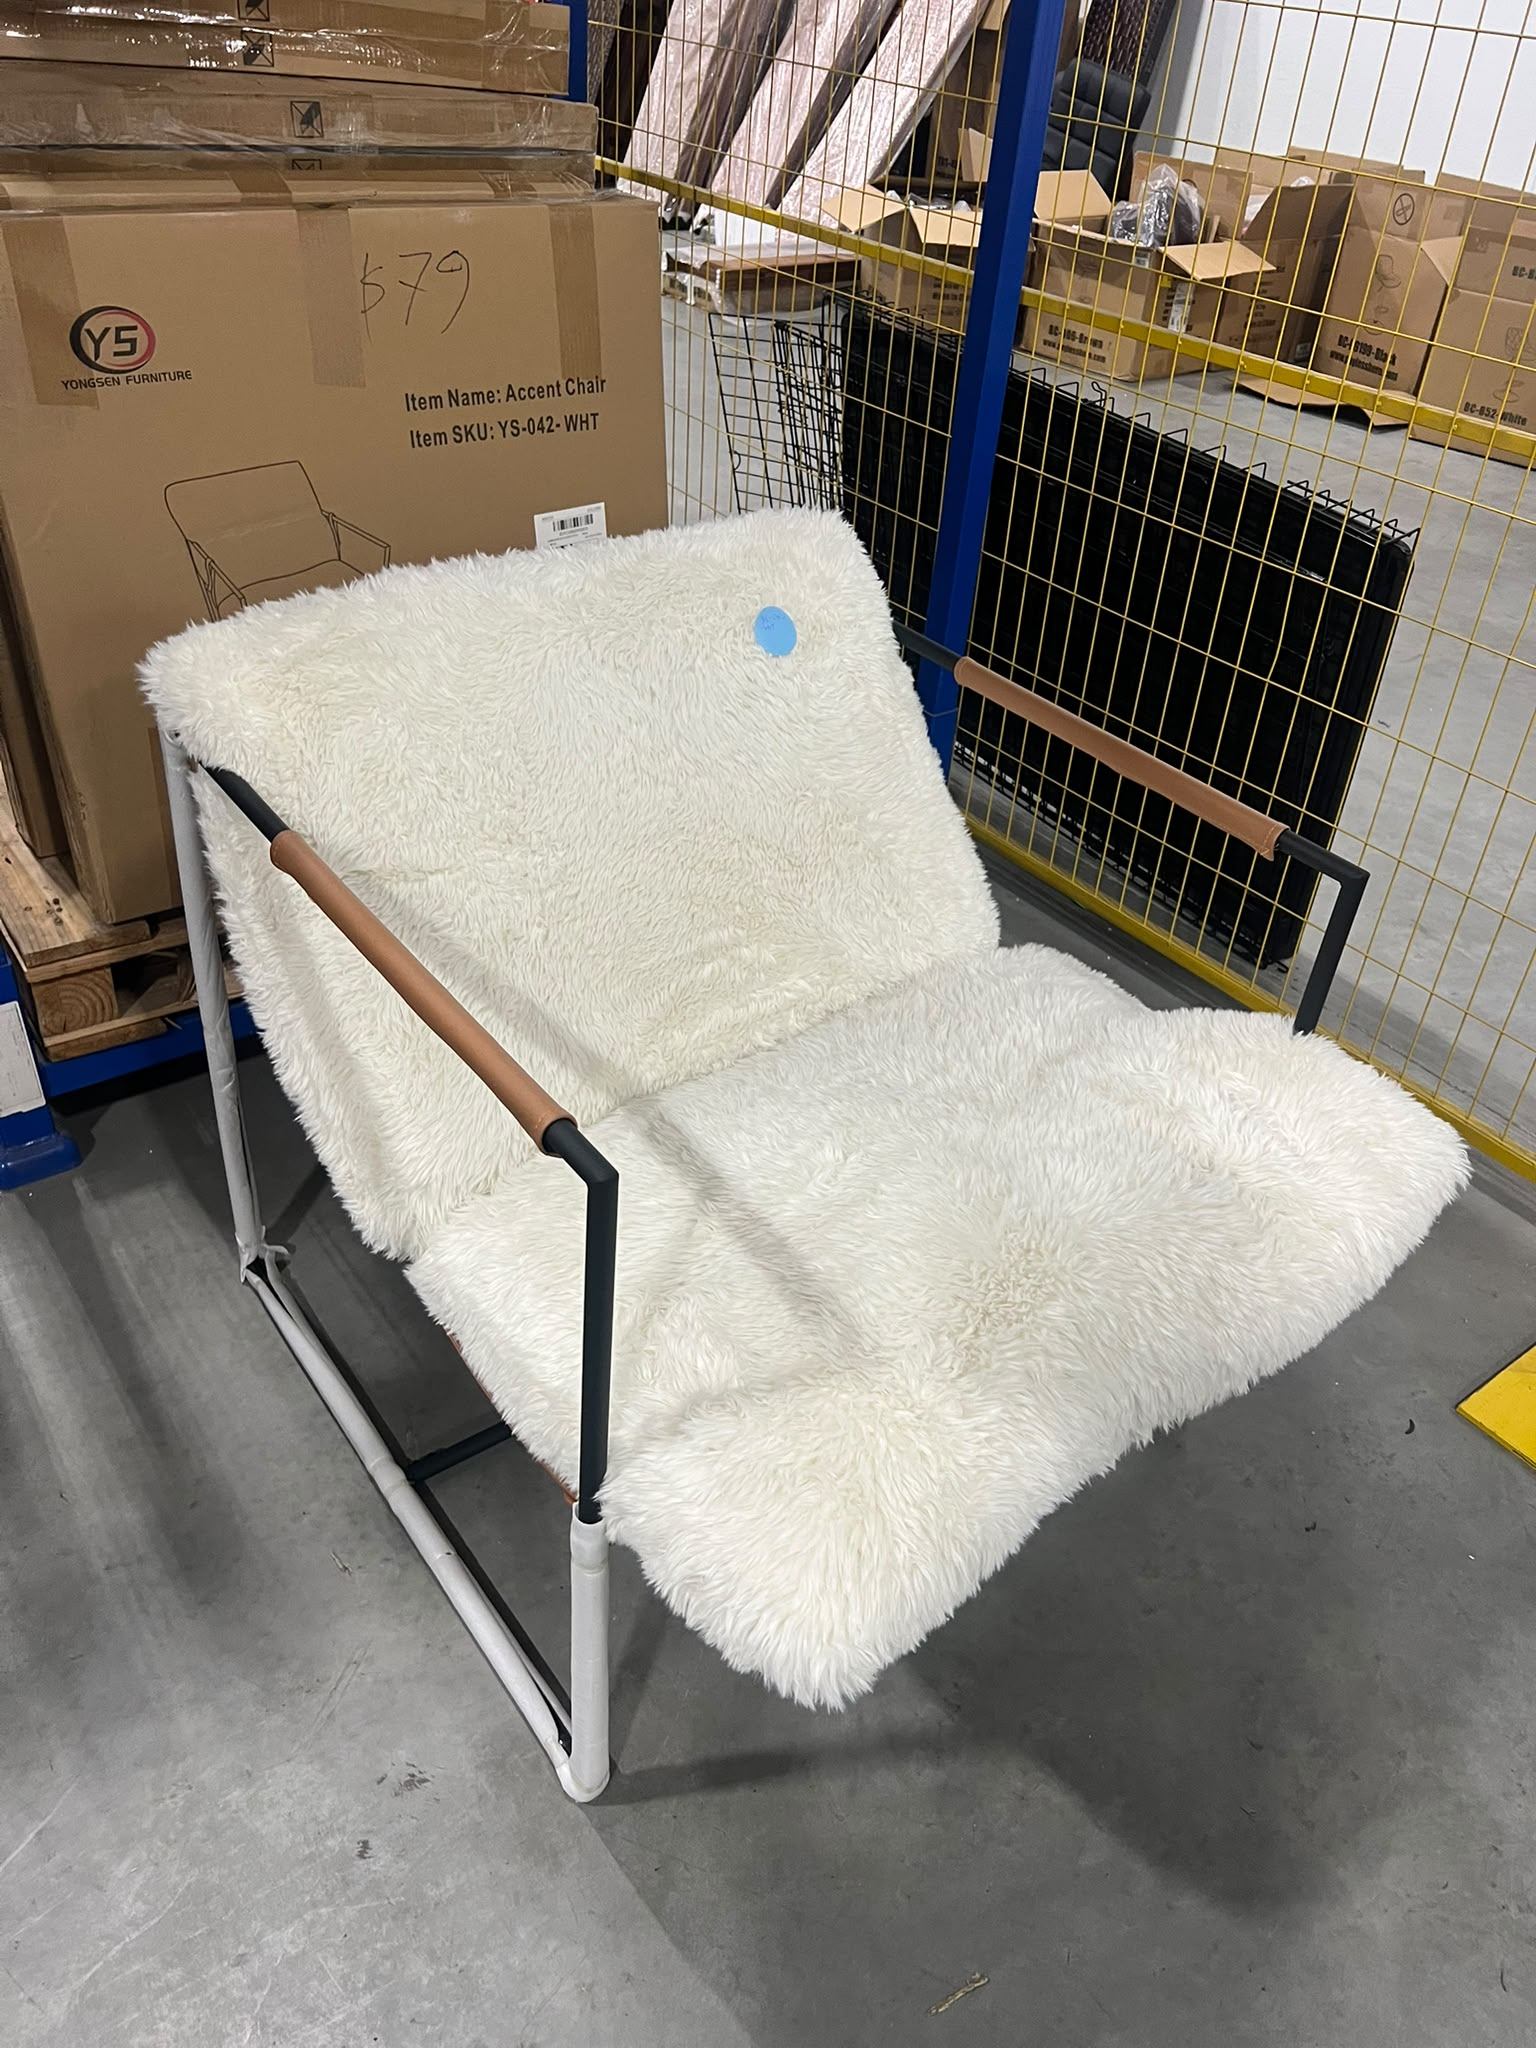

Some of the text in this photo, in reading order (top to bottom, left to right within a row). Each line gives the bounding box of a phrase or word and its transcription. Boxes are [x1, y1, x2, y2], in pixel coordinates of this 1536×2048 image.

[360, 250, 470, 345] $79
[84, 325, 138, 361] YS
[61, 370, 193, 391] YONGSEN FURNITURE
[404, 375, 606, 412] Item Name: Accent Chair
[409, 430, 448, 449] Item
[452, 422, 495, 444] SKU:
